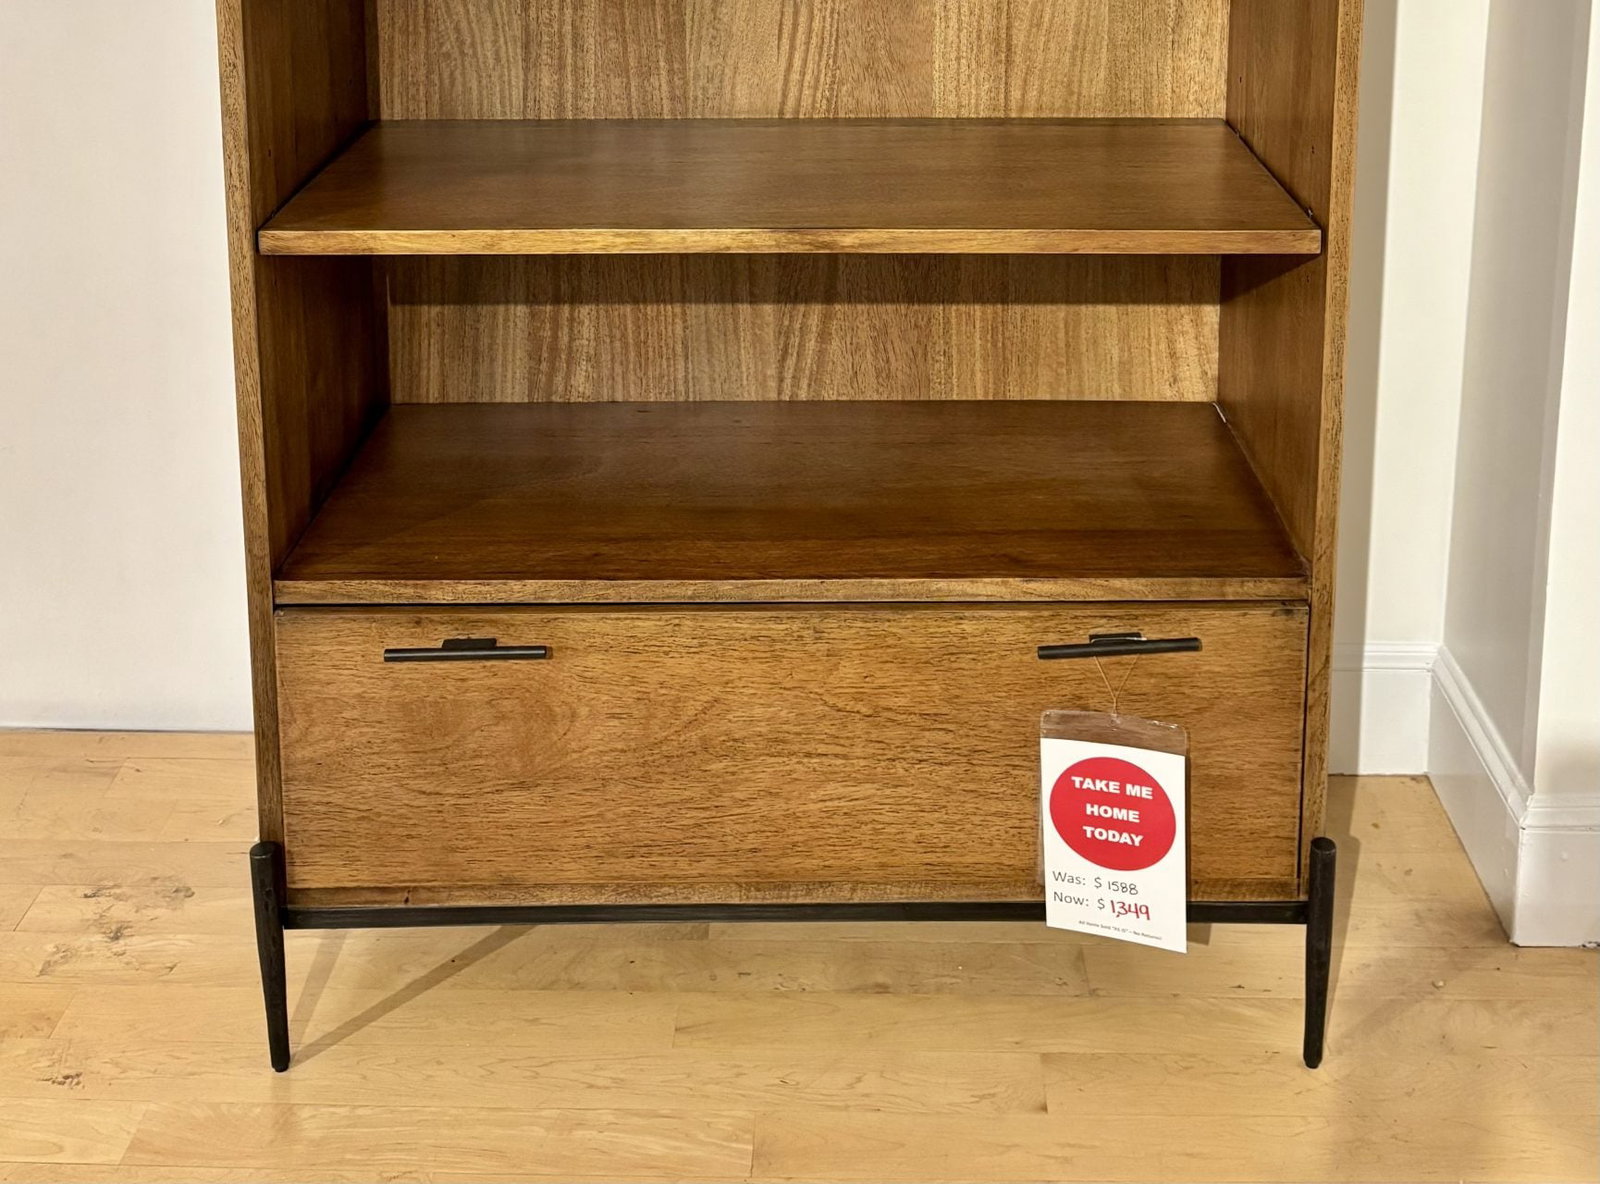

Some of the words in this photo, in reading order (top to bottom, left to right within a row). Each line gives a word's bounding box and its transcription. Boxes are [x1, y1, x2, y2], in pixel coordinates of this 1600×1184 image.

[1071, 776, 1121, 794] TAKE
[1125, 783, 1153, 800] ME
[1085, 803, 1140, 823] HOME
[1082, 825, 1144, 847] TODAY
[1052, 870, 1086, 886] Was:
[1094, 876, 1102, 889] $
[1107, 880, 1139, 896] 1588
[1053, 891, 1089, 907] Now:
[1097, 898, 1105, 910] $
